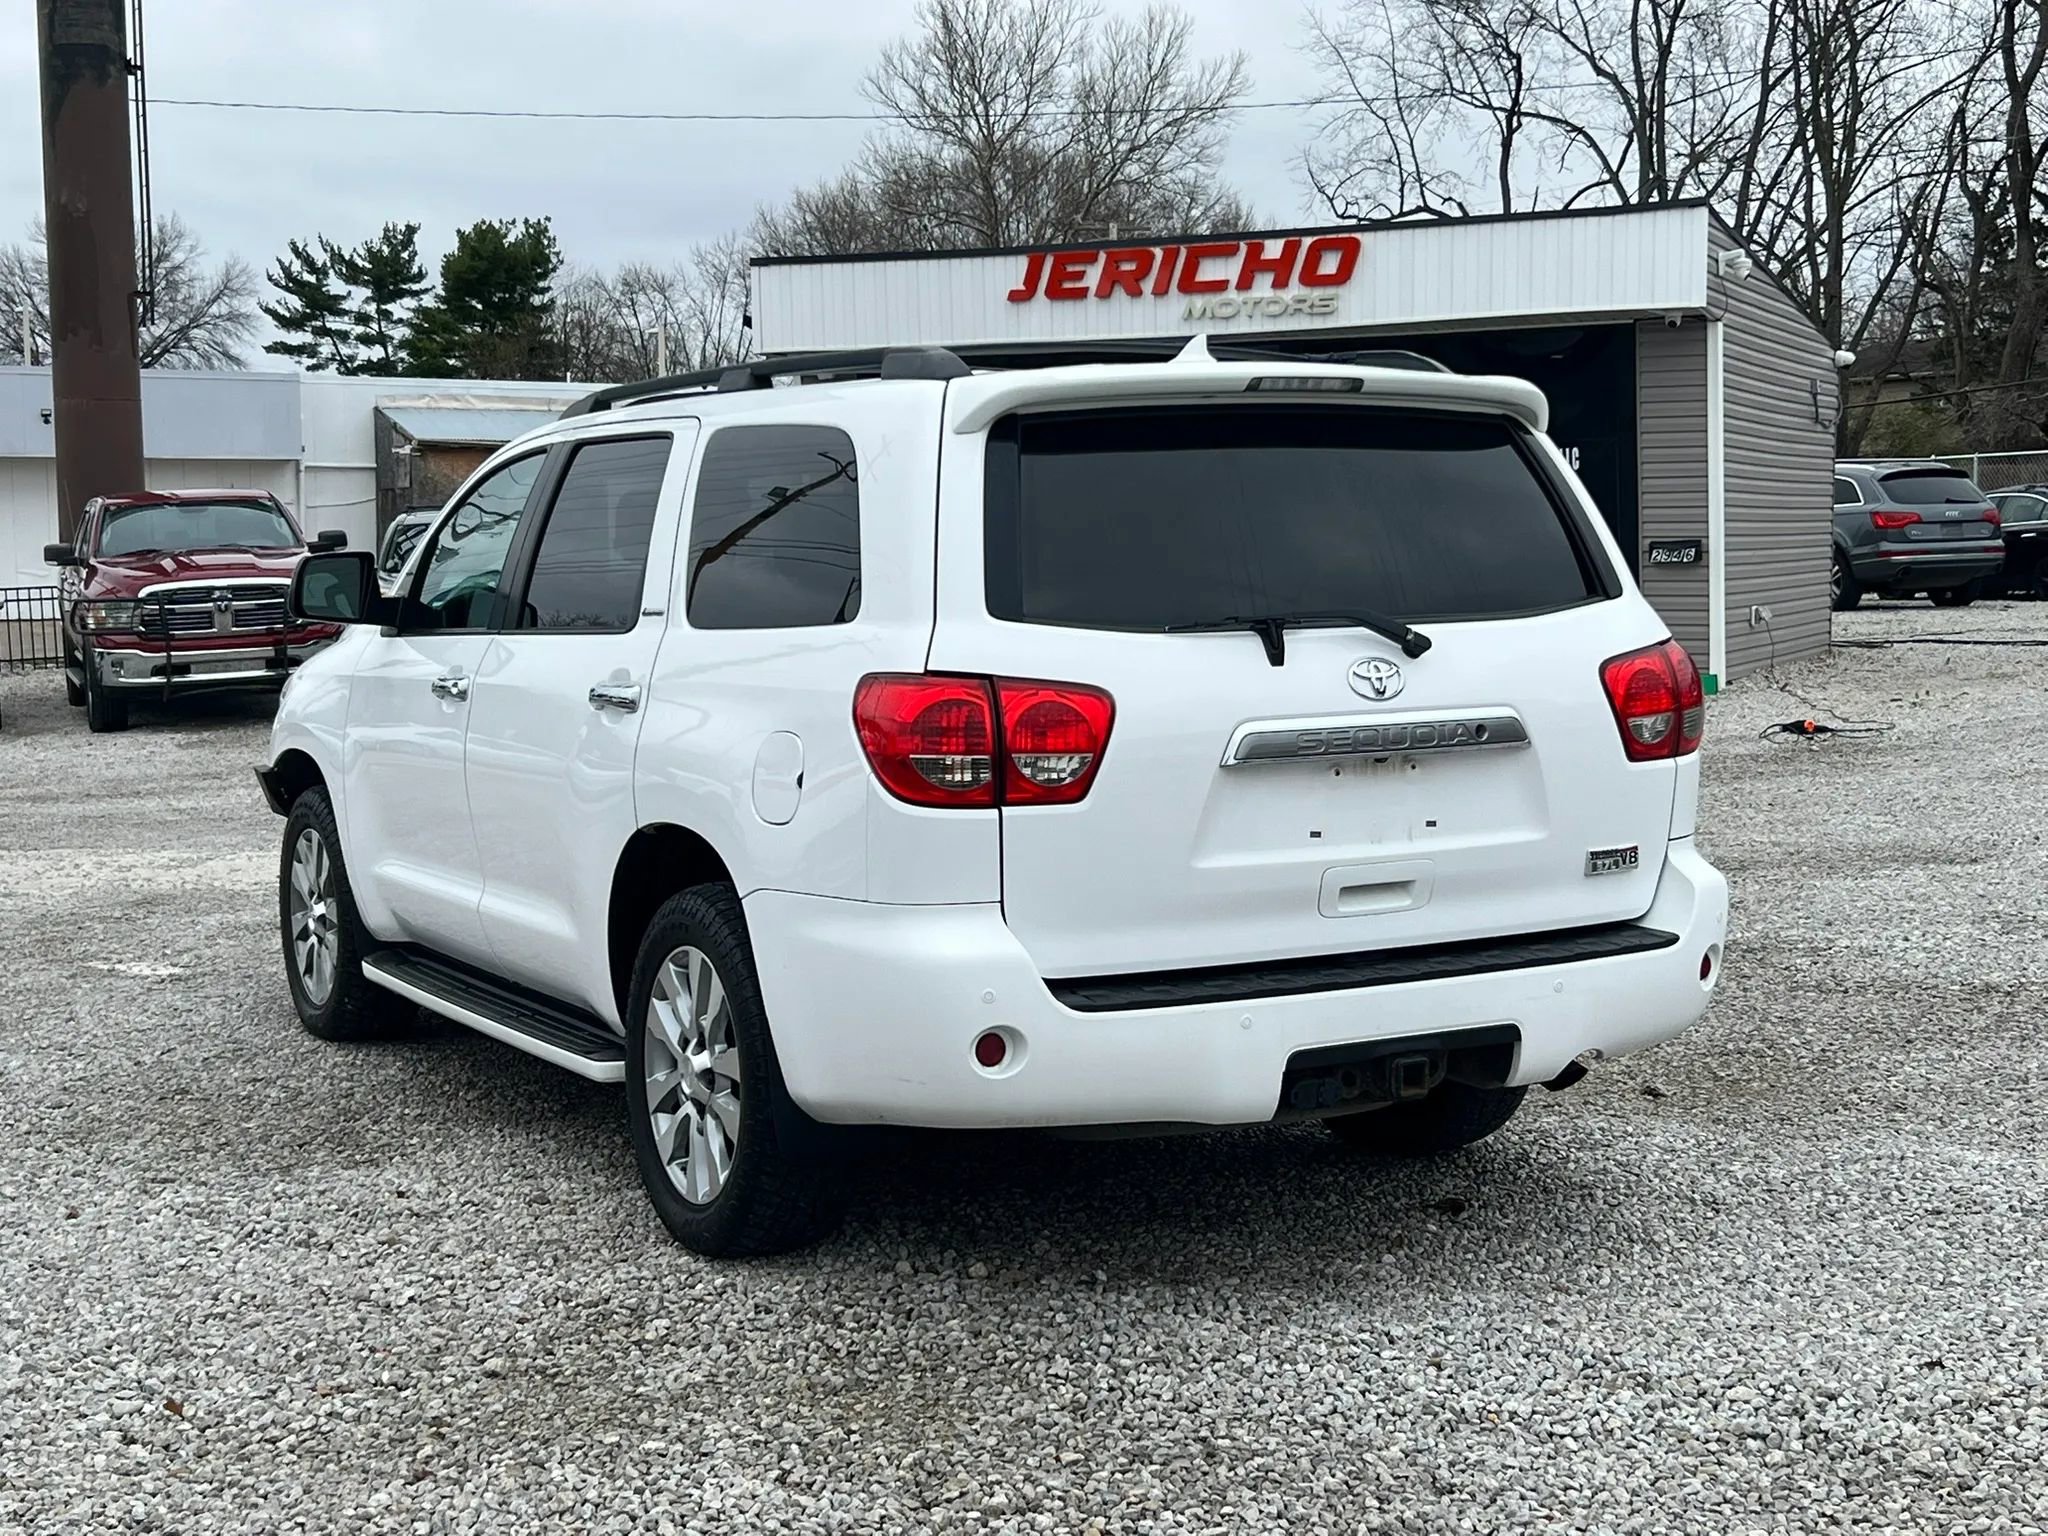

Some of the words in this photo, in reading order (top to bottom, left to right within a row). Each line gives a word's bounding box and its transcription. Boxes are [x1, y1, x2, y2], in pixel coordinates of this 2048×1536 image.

[1007, 236, 1361, 303] JERICHO
[1183, 293, 1338, 320] MOTORS
[1650, 548, 1696, 562] 2946
[1296, 724, 1477, 754] SEQUOIA
[1620, 850, 1638, 866] V8
